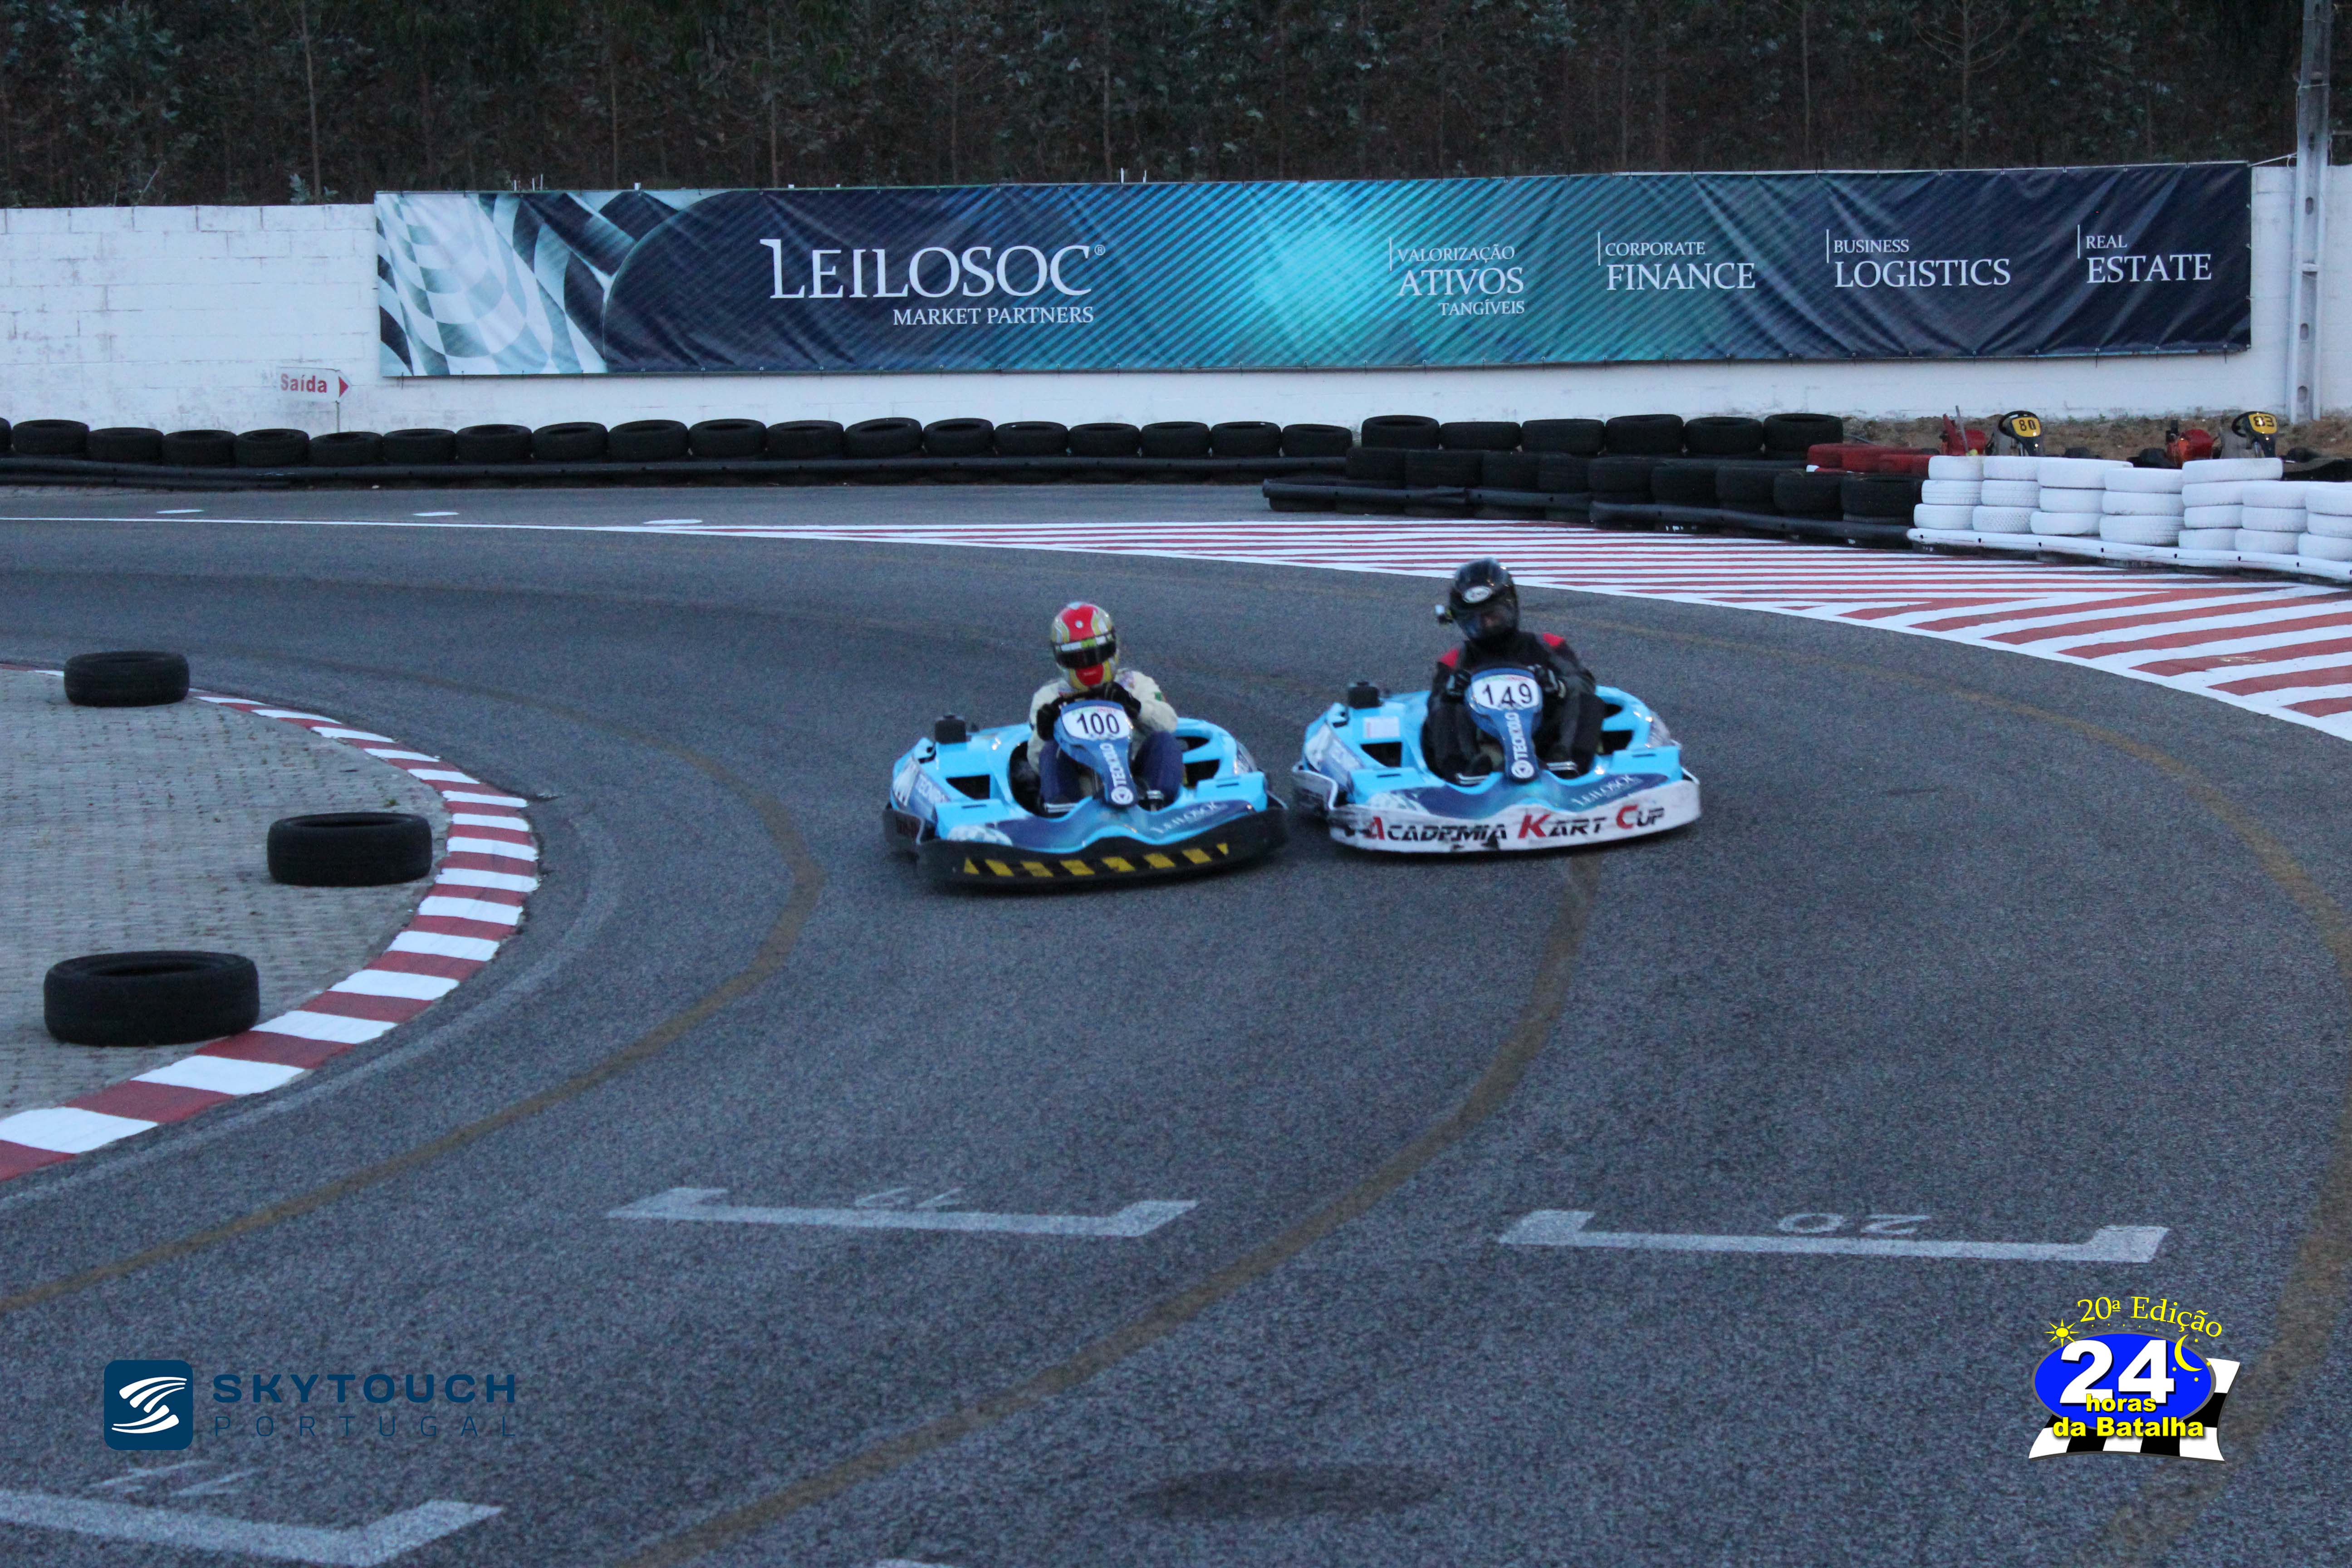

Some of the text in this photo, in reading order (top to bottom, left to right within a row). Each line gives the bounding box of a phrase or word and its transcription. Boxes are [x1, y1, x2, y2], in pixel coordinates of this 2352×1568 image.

[1605, 241, 1706, 256] CORPORATE
[1833, 239, 1909, 254] BUSINESS
[2086, 235, 2127, 250] REAL
[1397, 244, 1515, 264] VALORIZAÇÃO
[1607, 262, 1756, 291] FINANCE
[1835, 259, 2011, 288] LOGISTICS
[2087, 254, 2213, 284] ESTATE
[1397, 267, 1524, 296] ATIVOS
[893, 306, 1094, 325] MARKET PARTNERS
[1439, 299, 1525, 316] TANGÍVEIS
[280, 373, 328, 393] Saída
[2019, 420, 2036, 431] 80
[1482, 683, 1532, 707] 149
[1076, 713, 1120, 735] 100
[1518, 813, 1607, 839] KART
[1615, 804, 1665, 829] CUP
